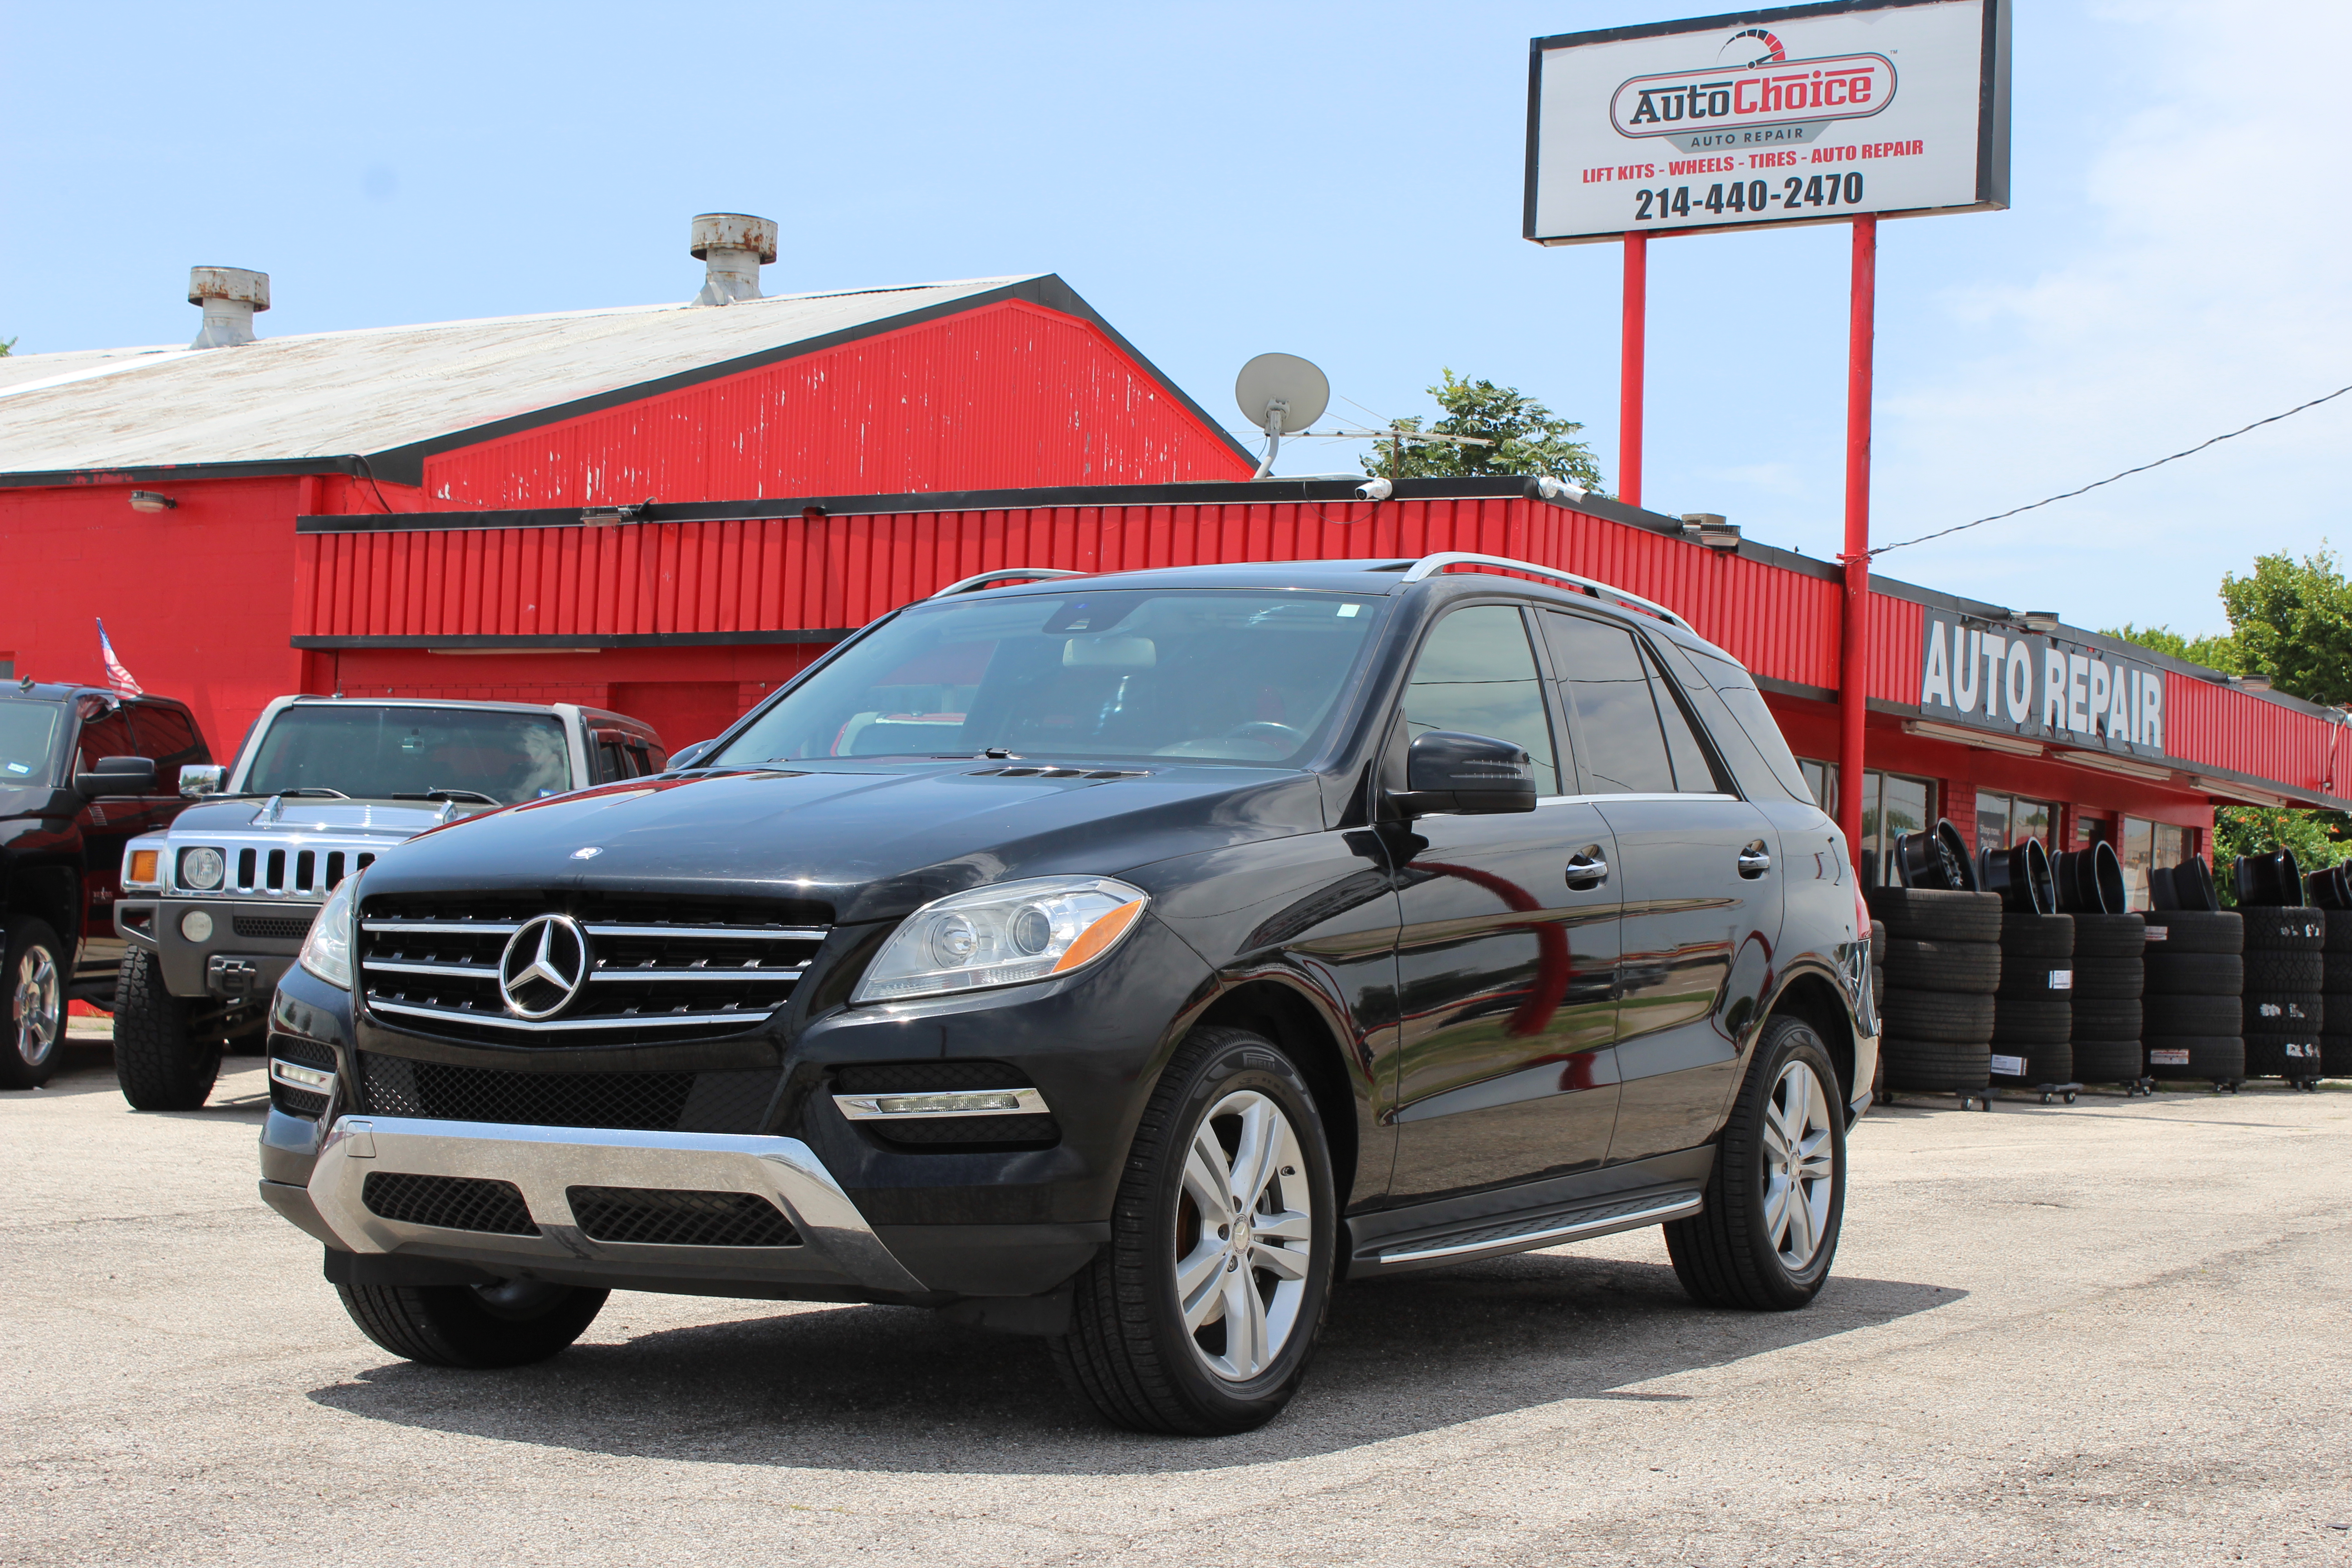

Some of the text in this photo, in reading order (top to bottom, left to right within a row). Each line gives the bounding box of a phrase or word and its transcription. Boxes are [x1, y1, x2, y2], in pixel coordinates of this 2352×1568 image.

[1629, 67, 1875, 125] AutoChoice
[1690, 128, 1803, 147] AUTO REPAIR
[1583, 167, 1614, 183] LIFT
[1617, 163, 1655, 181] KITS
[1668, 156, 1735, 176] WHEELS
[1749, 151, 1797, 169] TIRES
[1811, 145, 1857, 164] AUTO
[1862, 140, 1924, 159] REPAIR
[1635, 172, 1863, 220] 214-440-2470
[1922, 620, 2162, 748] AUTO REPAIR
[1242, 1052, 1275, 1070] PIRELLI
